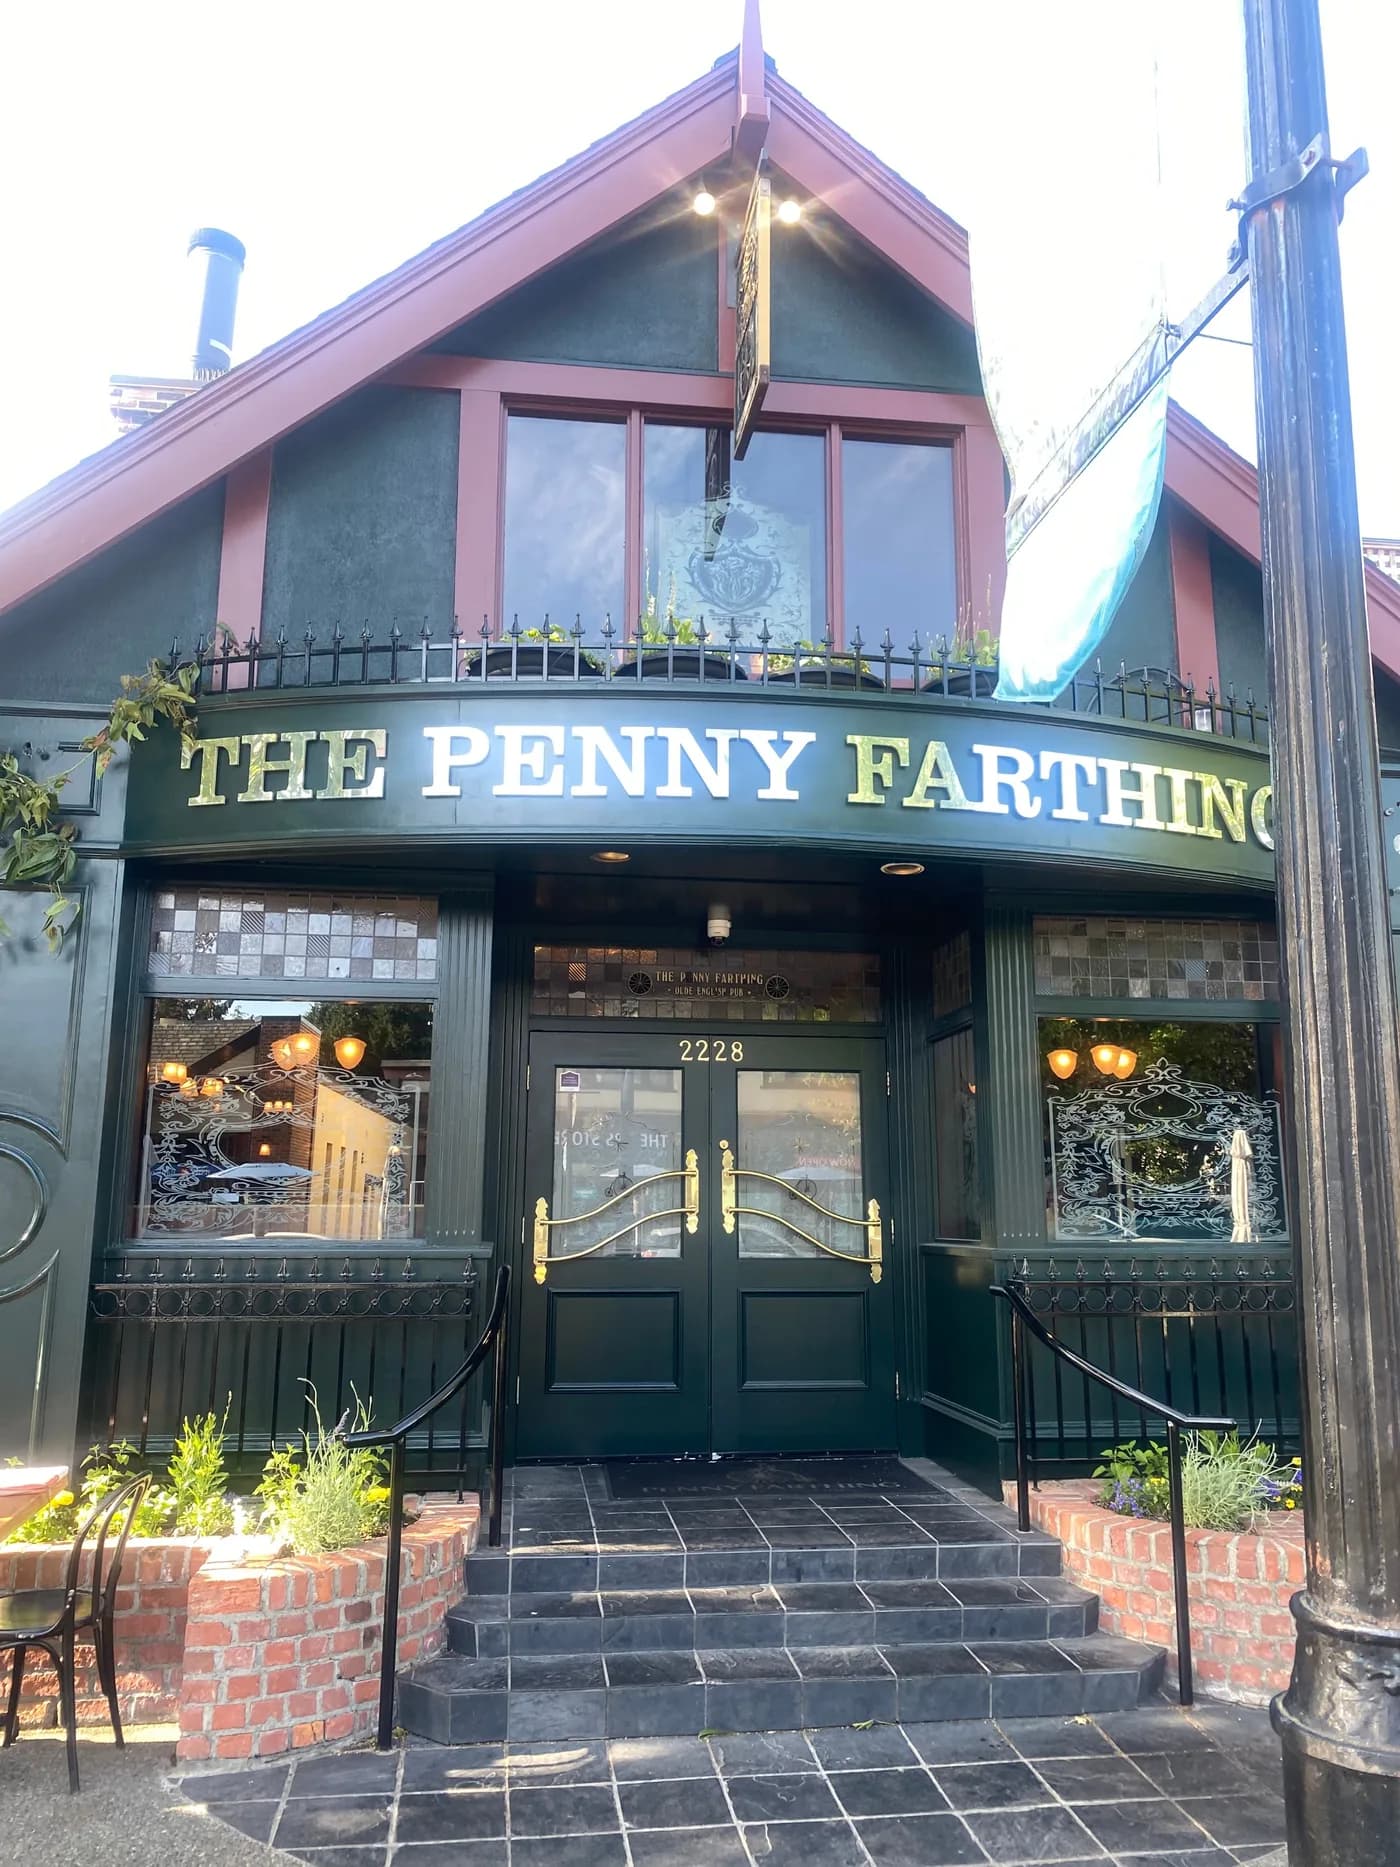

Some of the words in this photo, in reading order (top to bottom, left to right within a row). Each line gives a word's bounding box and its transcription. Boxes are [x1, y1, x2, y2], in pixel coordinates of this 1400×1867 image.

[180, 728, 387, 807] THE
[422, 724, 816, 800] PENNY
[656, 971, 674, 982] THE
[680, 971, 710, 983] PNNY
[674, 986, 694, 995] OLDE
[730, 988, 743, 997] PUB
[679, 1039, 744, 1062] 2228
